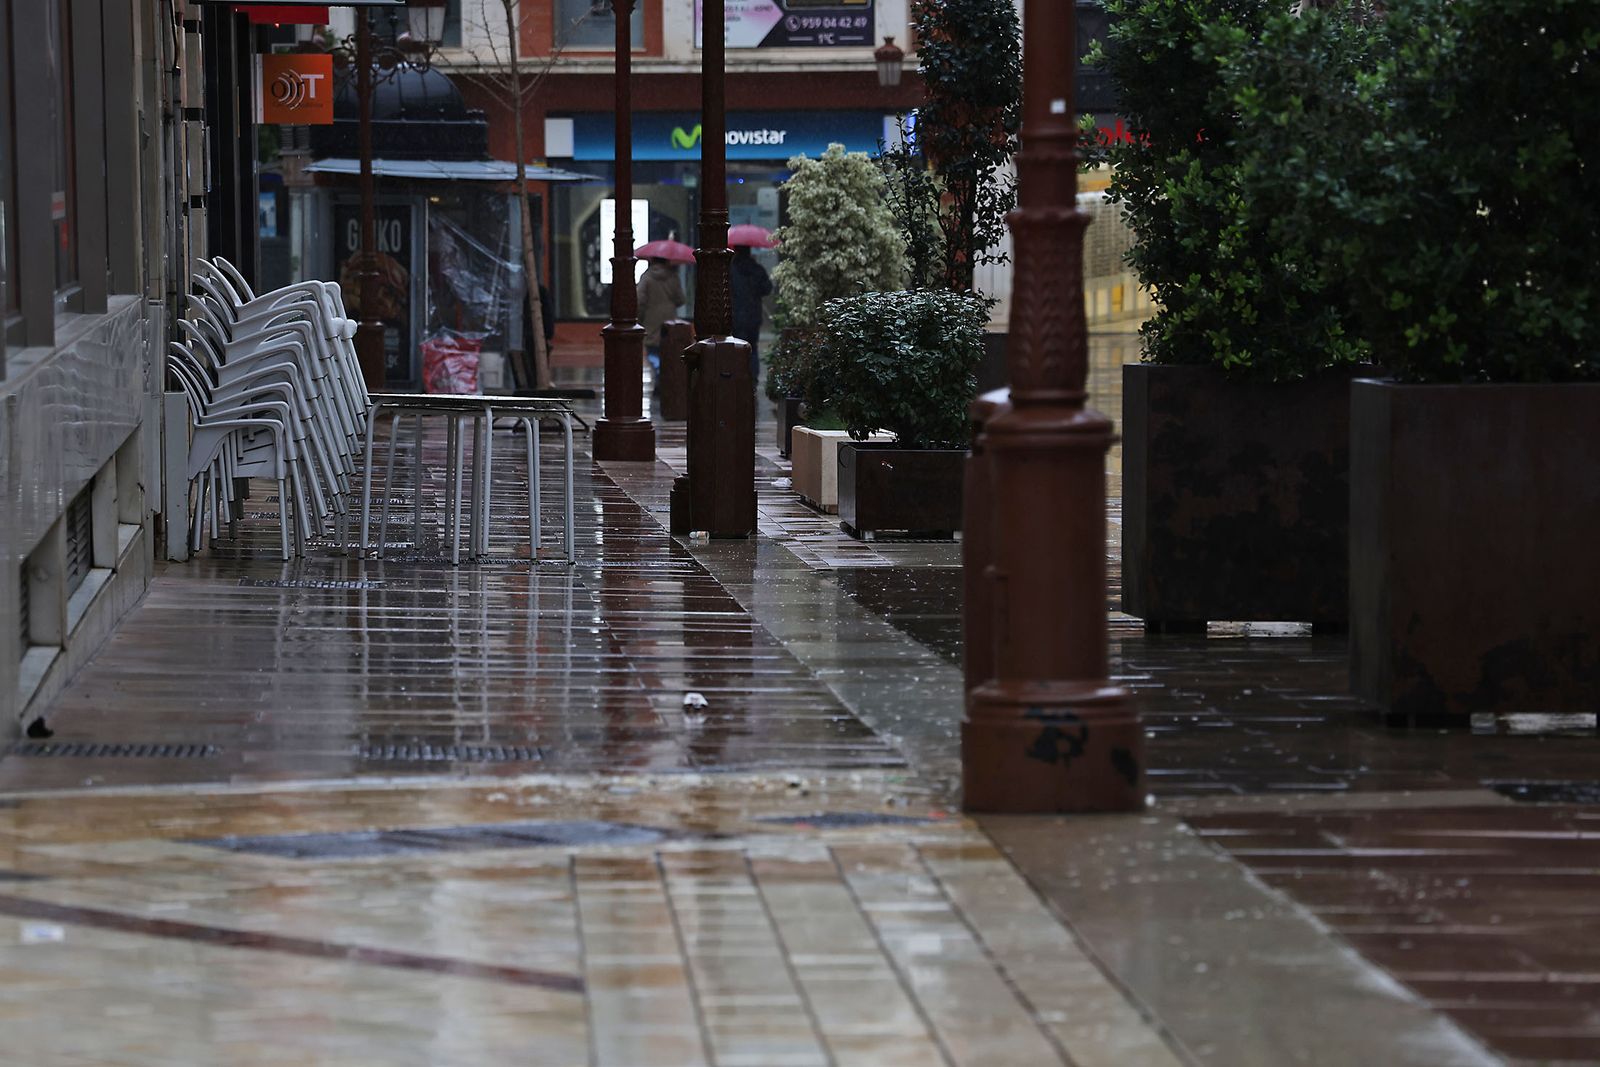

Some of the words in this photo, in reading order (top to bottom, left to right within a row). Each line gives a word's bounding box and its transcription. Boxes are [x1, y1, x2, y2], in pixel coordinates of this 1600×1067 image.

[802, 17, 821, 29] 959
[824, 17, 837, 28] 04
[839, 17, 852, 28] 42
[854, 16, 868, 28] 49
[725, 129, 787, 146] ovistar
